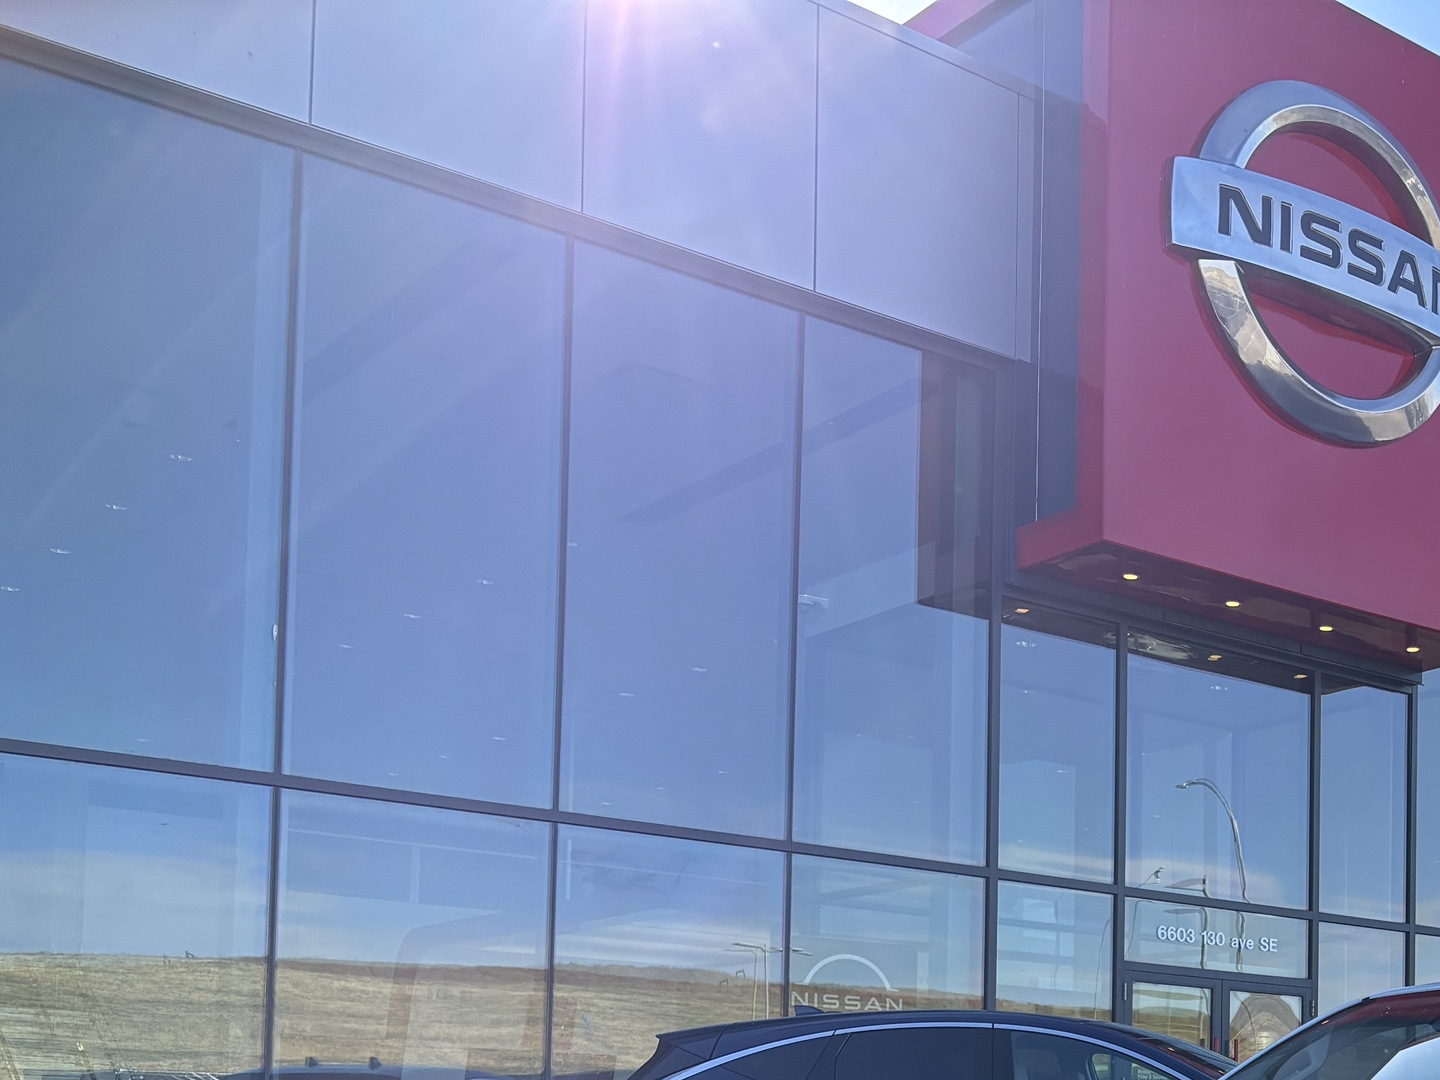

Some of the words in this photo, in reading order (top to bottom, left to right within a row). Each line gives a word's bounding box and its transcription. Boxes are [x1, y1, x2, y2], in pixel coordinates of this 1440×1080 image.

[1157, 924, 1195, 944] 6603
[1200, 930, 1225, 947] 130
[1230, 937, 1254, 950] ave
[1259, 936, 1278, 953] SE
[791, 990, 903, 1012] NISSAN
